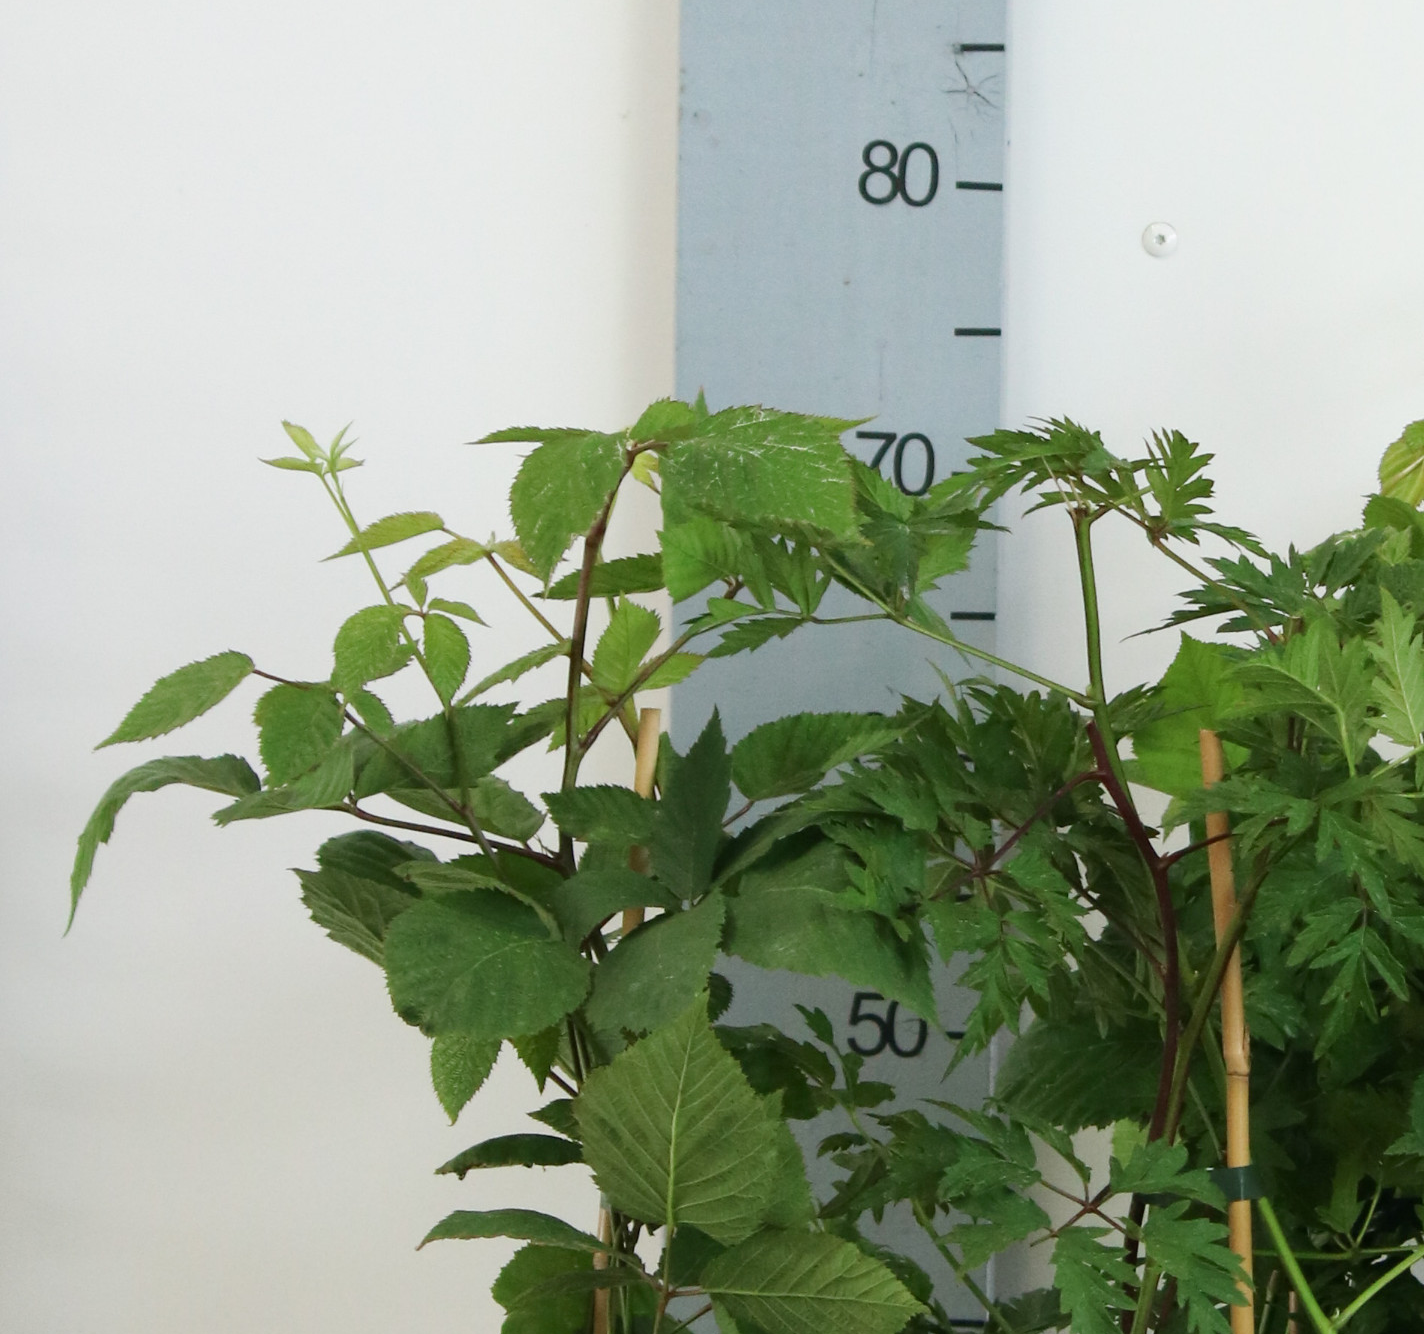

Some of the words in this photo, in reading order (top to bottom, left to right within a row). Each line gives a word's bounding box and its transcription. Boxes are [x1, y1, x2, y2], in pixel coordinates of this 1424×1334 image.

[858, 140, 939, 206] 80
[856, 431, 936, 496] 70
[847, 992, 928, 1058] 50
